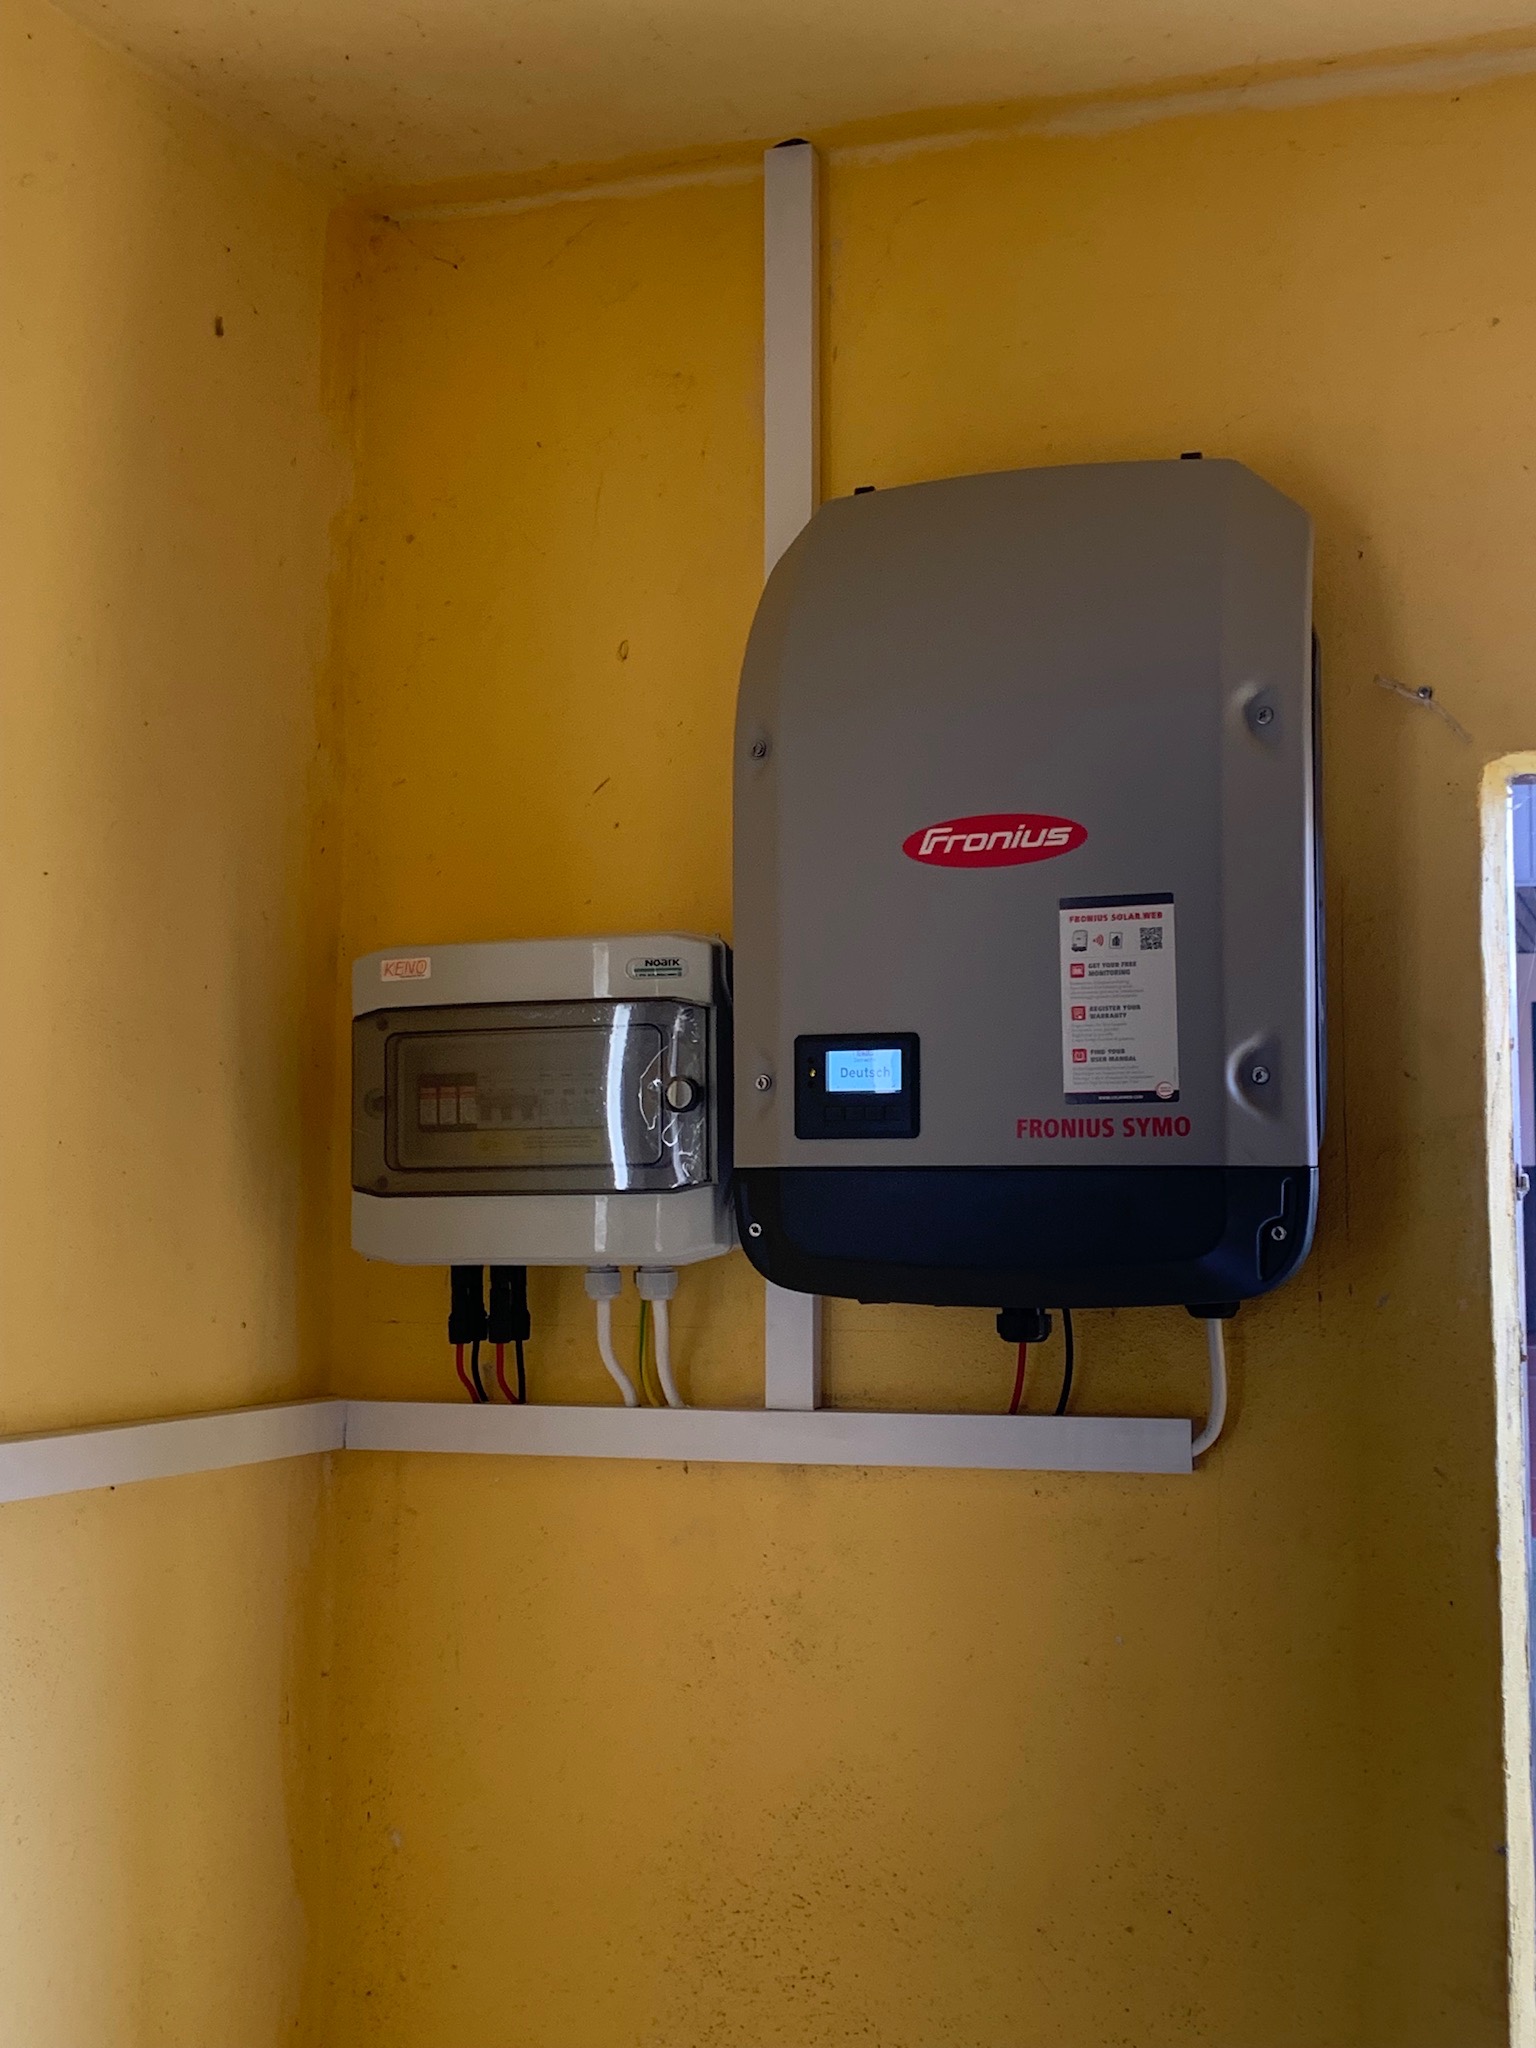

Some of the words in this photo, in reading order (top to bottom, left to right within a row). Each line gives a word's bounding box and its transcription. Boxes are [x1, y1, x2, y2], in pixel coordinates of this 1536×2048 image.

[918, 824, 1073, 856] Fronius
[1069, 914, 1108, 923] FRONIUS
[384, 959, 427, 977] KENO
[1088, 969, 1131, 977] MONITORING
[840, 1066, 890, 1078] Deutsch
[1016, 1118, 1114, 1138] FRONIUS
[1122, 1116, 1191, 1138] SYMO
